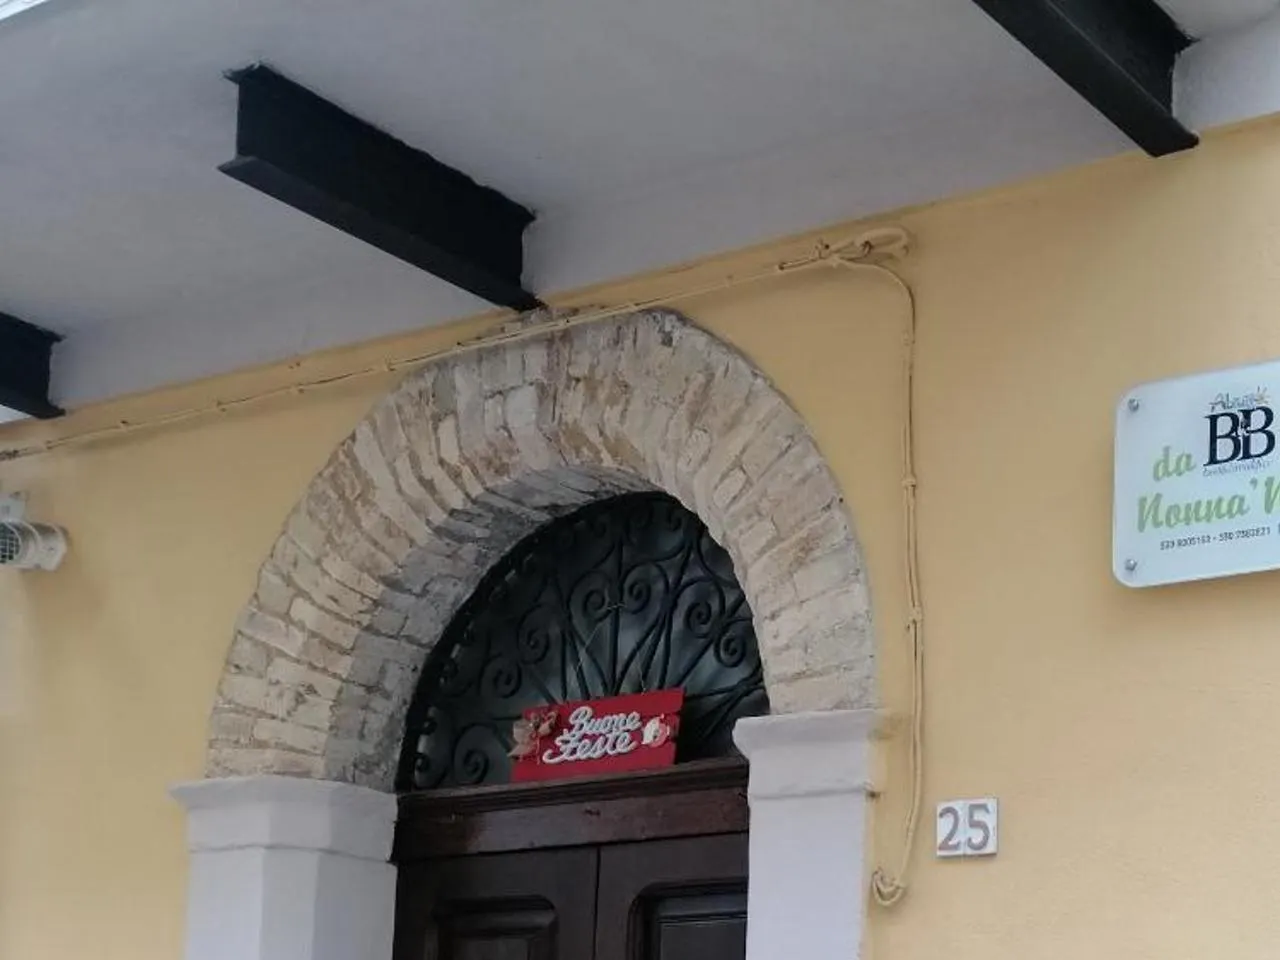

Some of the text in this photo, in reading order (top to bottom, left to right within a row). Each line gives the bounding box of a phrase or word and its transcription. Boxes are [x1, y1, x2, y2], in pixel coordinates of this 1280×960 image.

[1153, 446, 1196, 482] da
[1136, 493, 1250, 533] Nonna
[568, 706, 642, 737] Buone
[938, 803, 991, 851] 25
